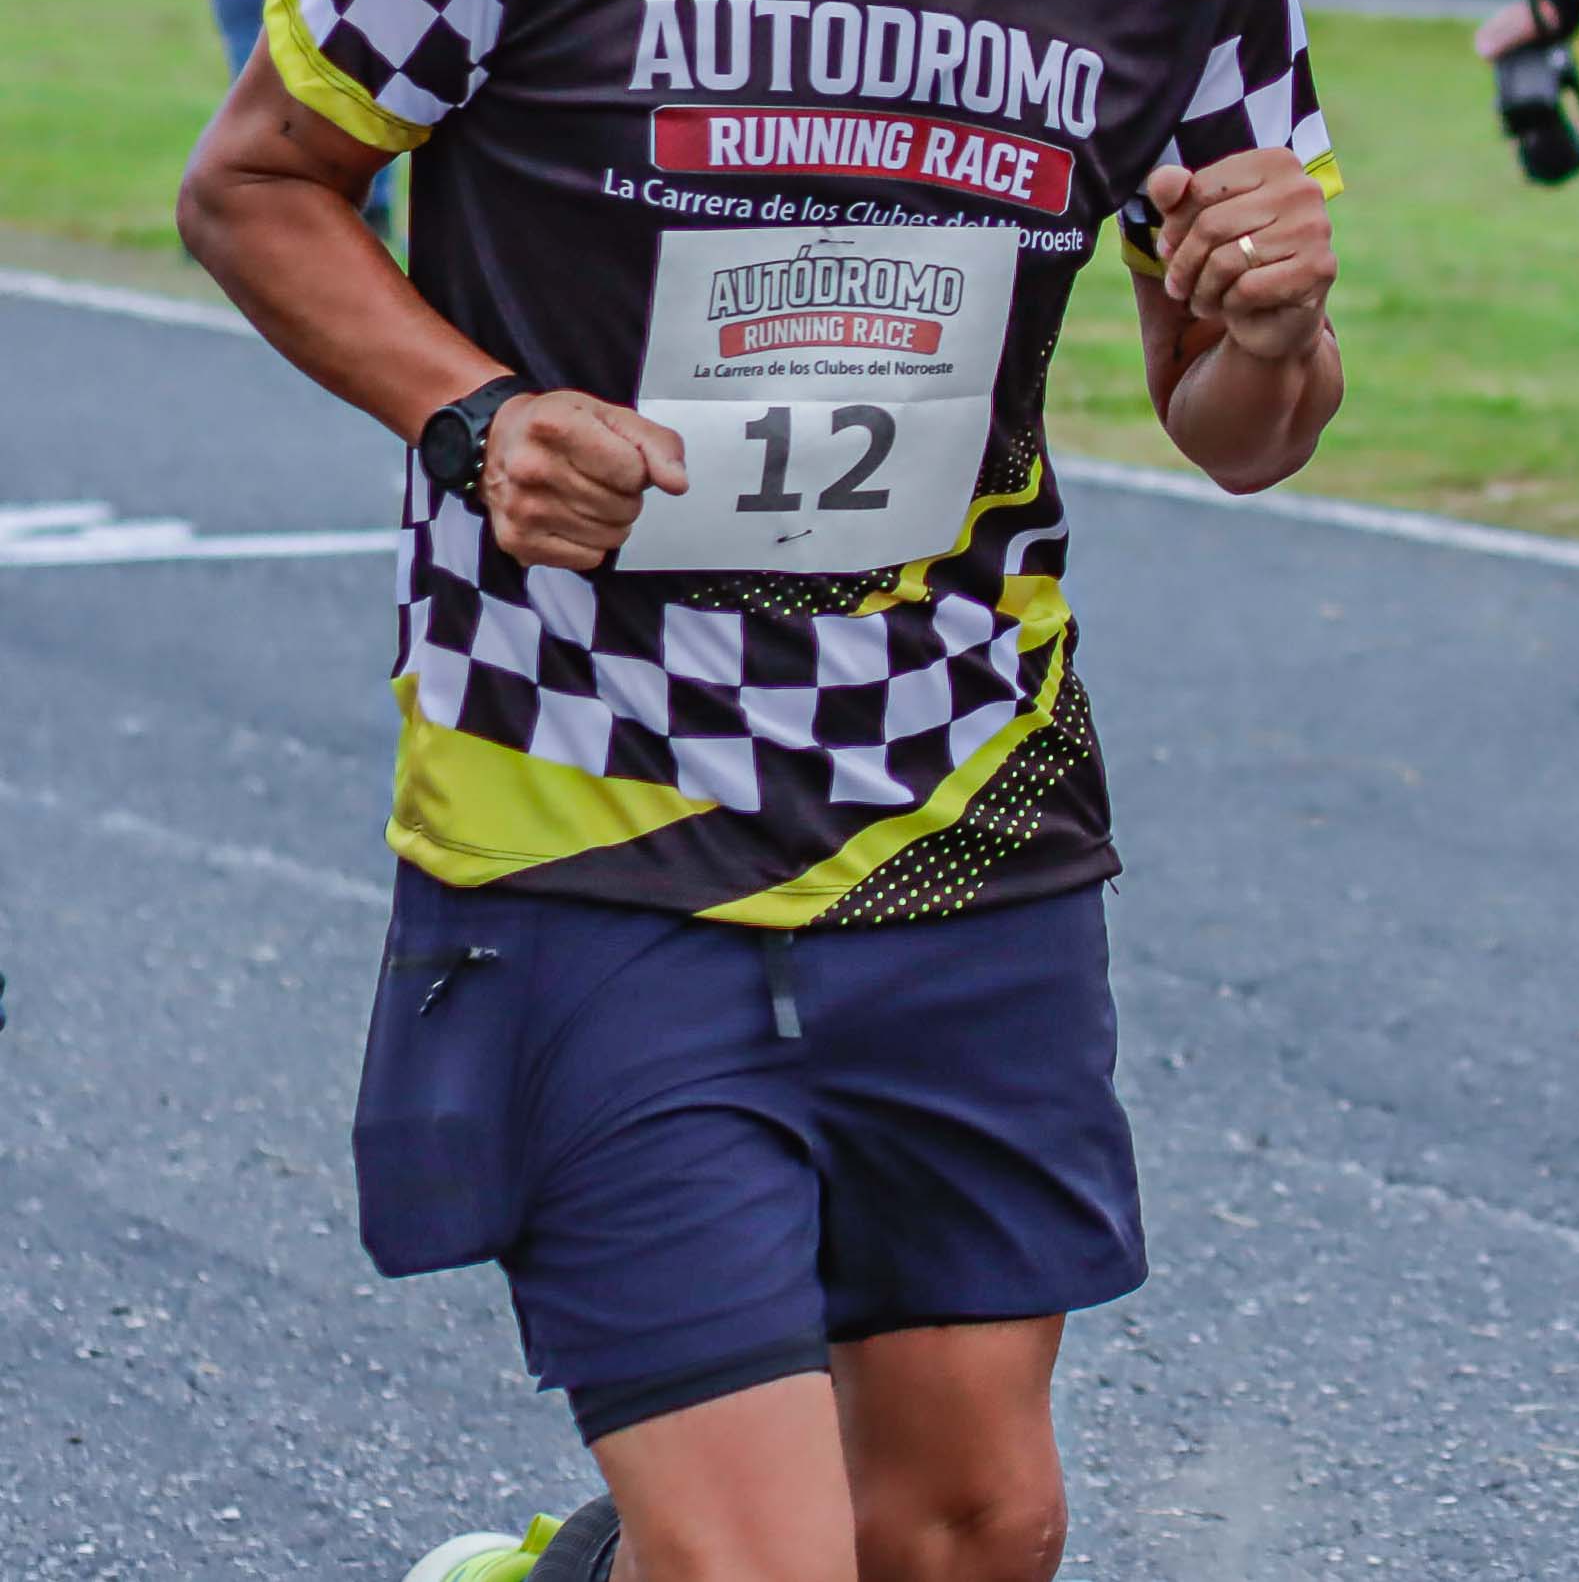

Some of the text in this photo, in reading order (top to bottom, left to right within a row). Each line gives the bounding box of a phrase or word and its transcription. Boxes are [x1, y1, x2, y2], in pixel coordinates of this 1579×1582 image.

[708, 116, 1040, 200] RUNNING RACE
[602, 167, 636, 200] La
[642, 178, 752, 219] Carrera
[760, 194, 796, 223] de
[801, 196, 838, 223] los
[998, 219, 1084, 252] oroeste
[707, 245, 966, 321] AUTÓDROMO
[694, 360, 954, 379] La Carrera de los Clubes del Noroeste
[743, 317, 917, 351] RUNNING RACE
[735, 404, 897, 513] 12
